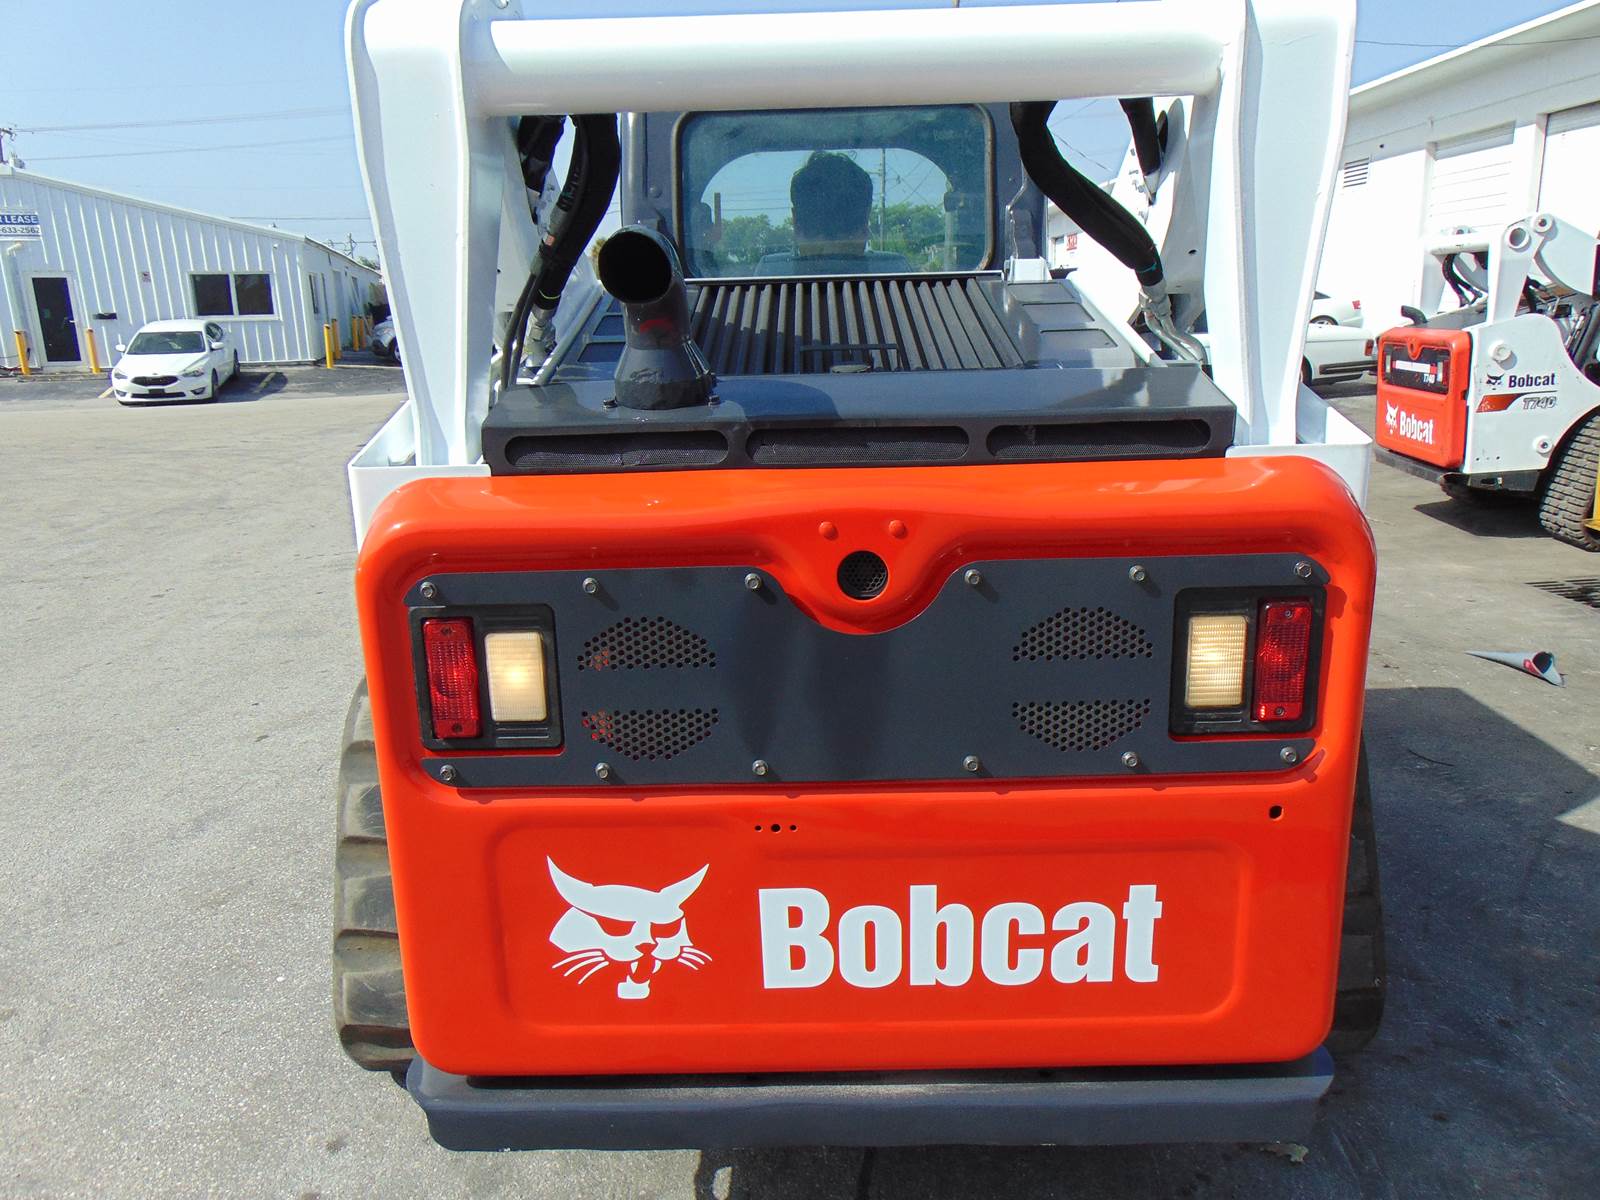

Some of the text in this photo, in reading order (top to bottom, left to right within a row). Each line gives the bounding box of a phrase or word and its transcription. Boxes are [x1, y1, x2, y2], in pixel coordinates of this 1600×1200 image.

[4, 215, 38, 224] LEASE
[1508, 373, 1555, 388] Bobcat
[1522, 396, 1557, 410] T740
[1400, 411, 1434, 445] Bobcat
[758, 884, 1162, 989] Bobcat
